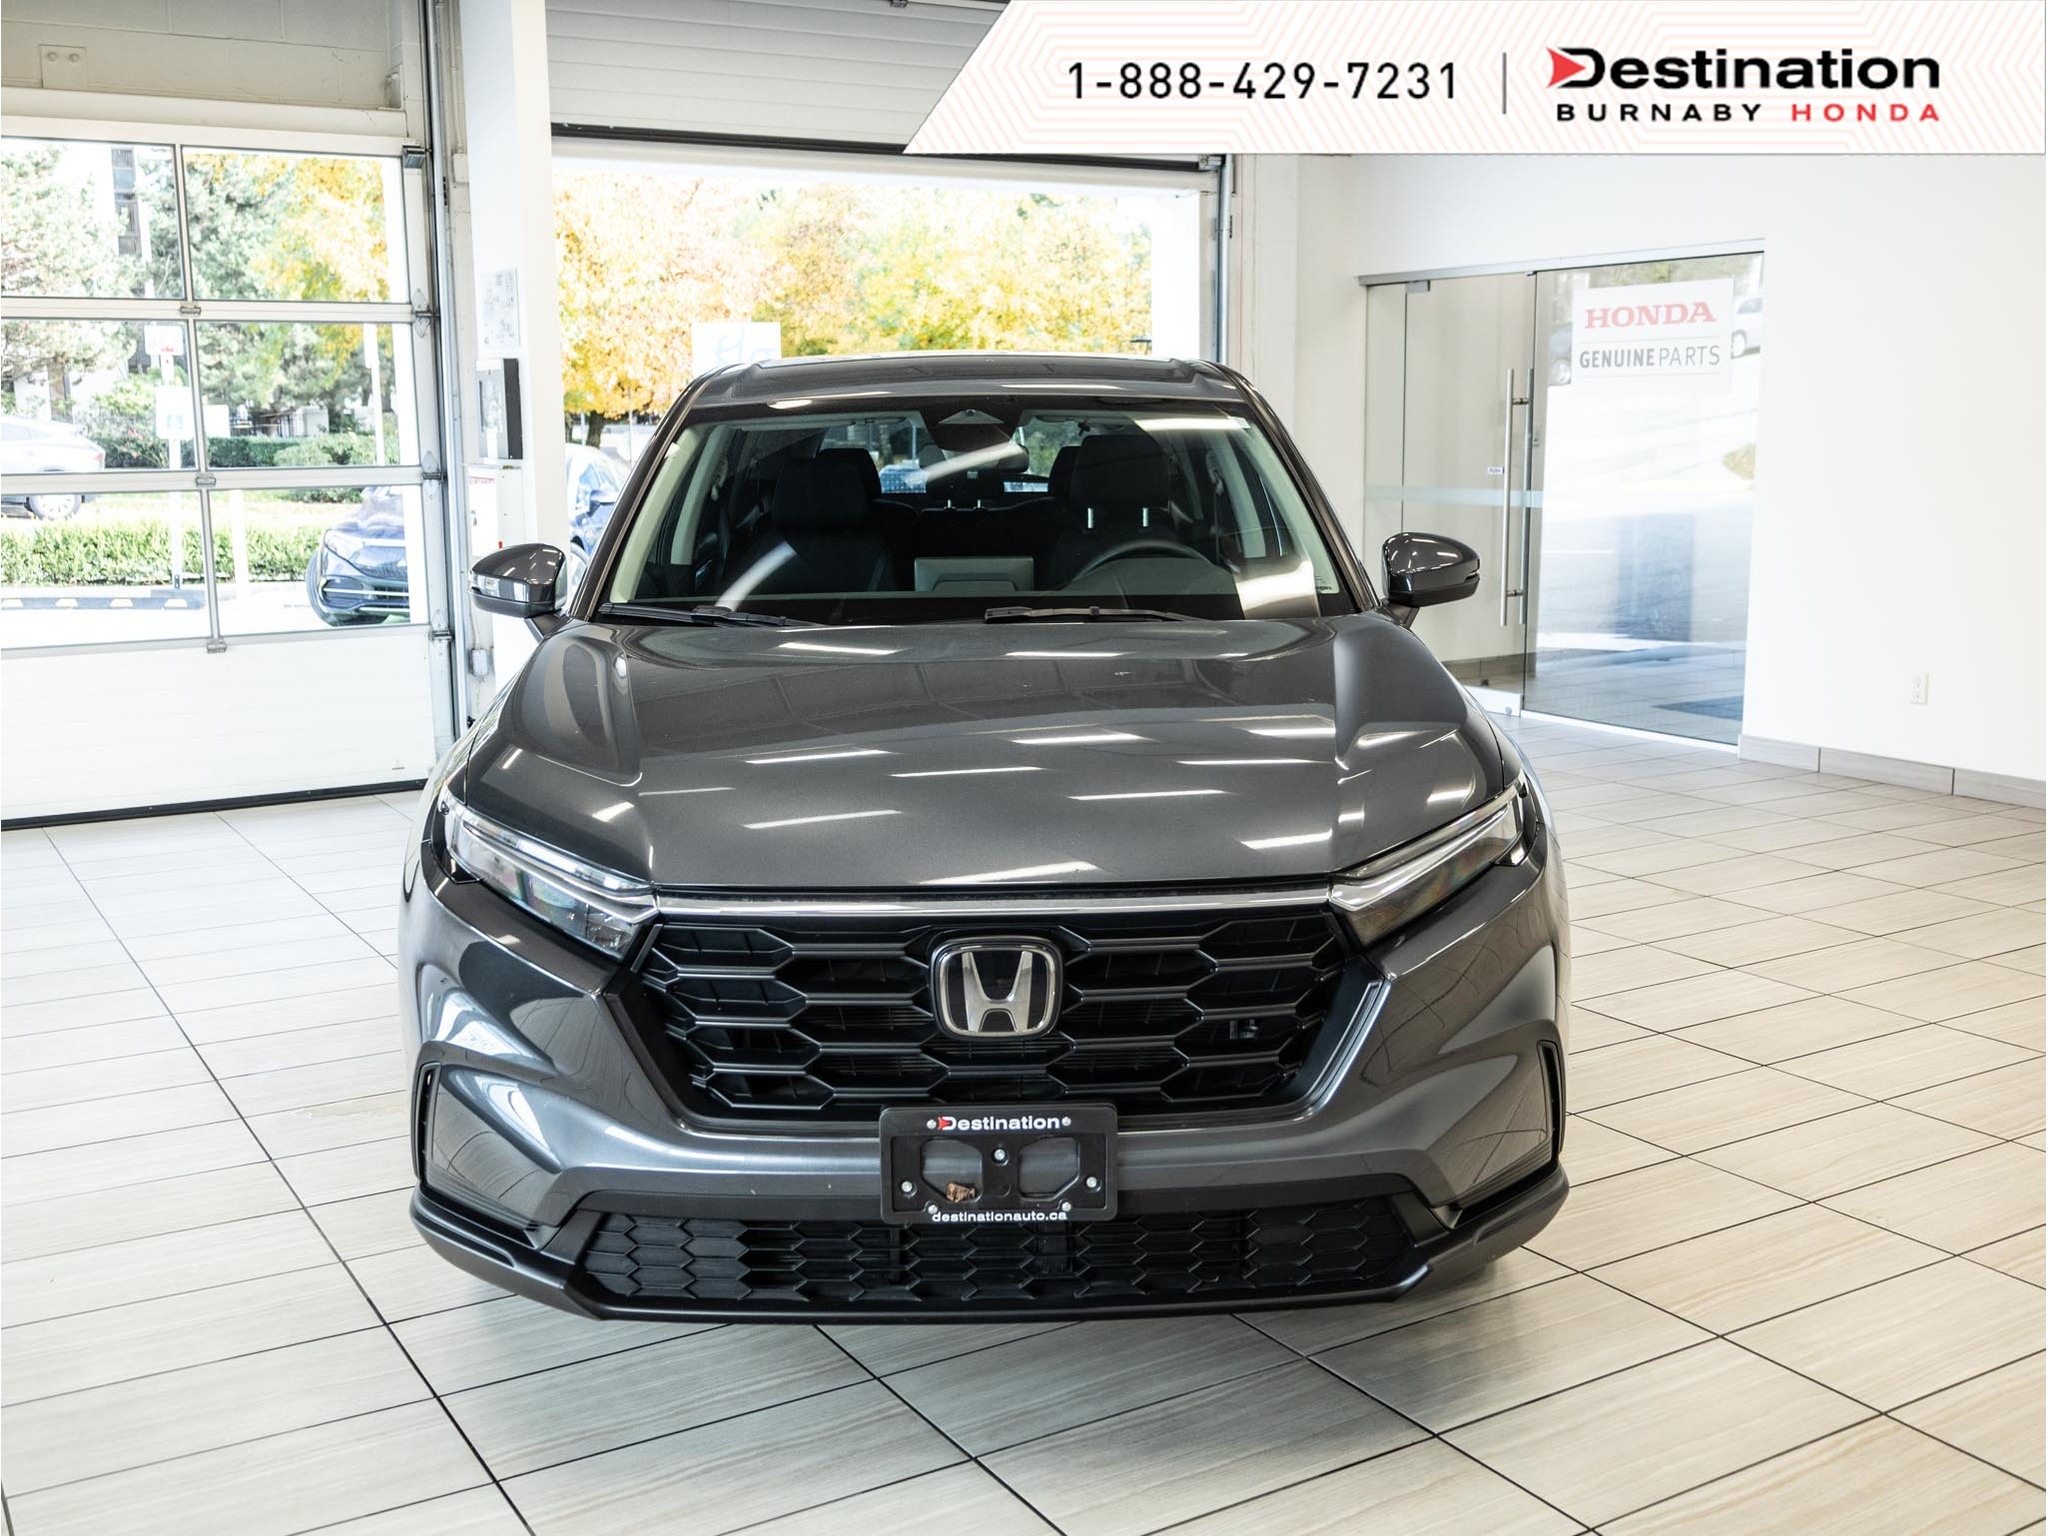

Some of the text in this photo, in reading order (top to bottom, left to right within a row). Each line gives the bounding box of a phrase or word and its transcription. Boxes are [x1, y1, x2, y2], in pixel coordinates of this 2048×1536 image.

[1584, 301, 1717, 329] HONDA
[938, 1115, 1061, 1131] Destination
[931, 1209, 1068, 1223] destinationauto.ca
